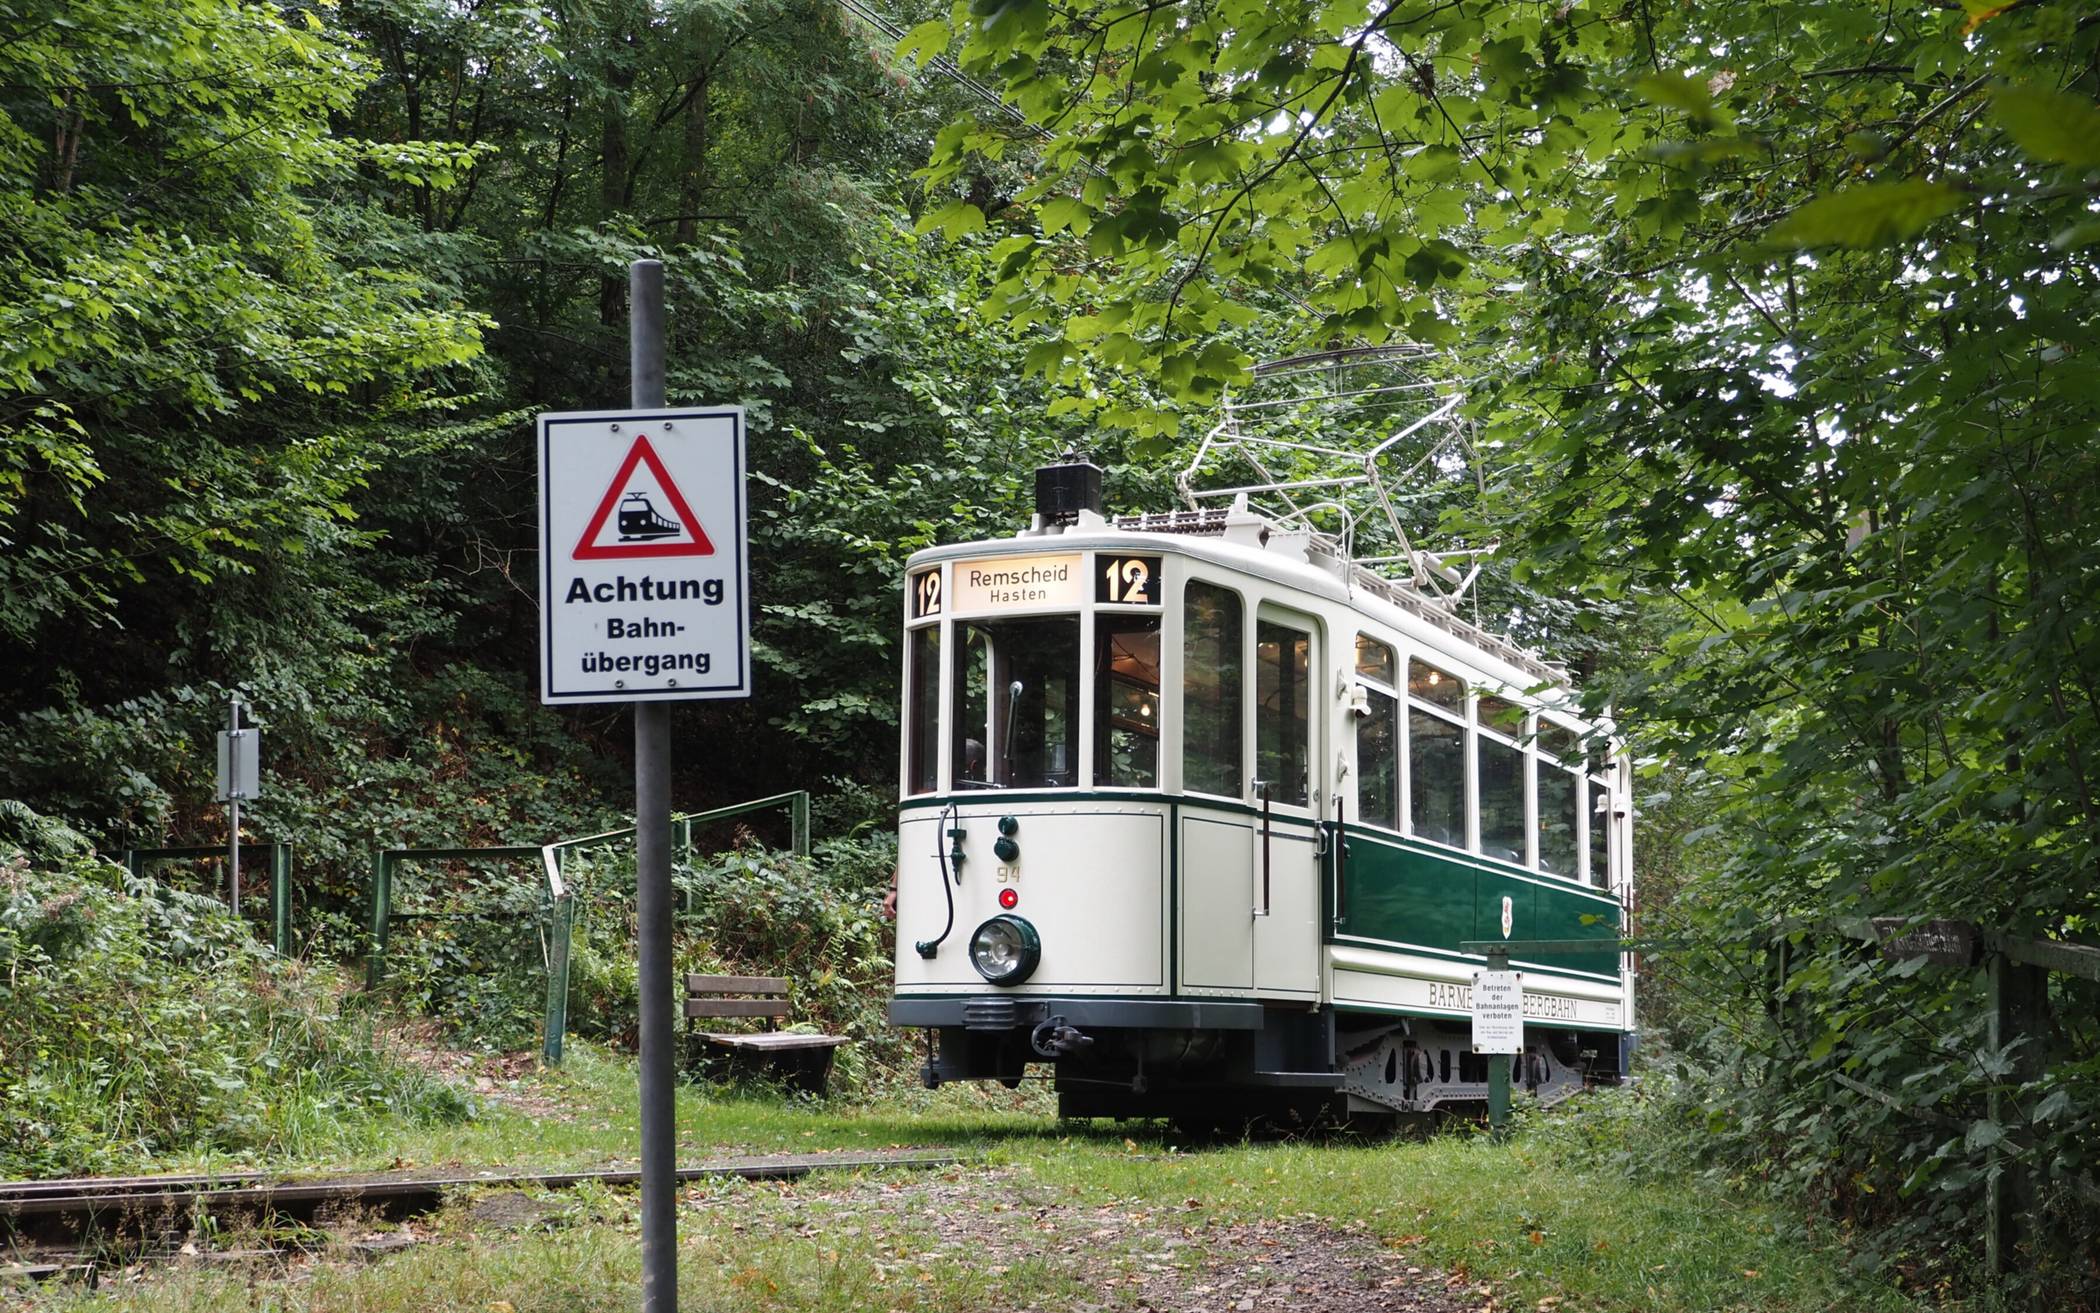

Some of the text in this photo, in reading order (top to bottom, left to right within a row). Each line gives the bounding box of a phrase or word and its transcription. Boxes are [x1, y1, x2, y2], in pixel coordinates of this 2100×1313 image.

[970, 564, 1068, 587] Remscheid
[1106, 559, 1149, 602] 12
[565, 576, 724, 606] Achtung
[917, 571, 941, 616] 12
[990, 589, 1046, 603] Hasten
[607, 617, 685, 639] Bahn-
[582, 652, 711, 676] übergang
[996, 866, 1021, 883] 94
[1482, 984, 1512, 992] Betreten
[1429, 983, 1473, 1009] BARME
[1523, 994, 1577, 1019] BERGBAHN
[1475, 1002, 1519, 1011] Bahnanlagen
